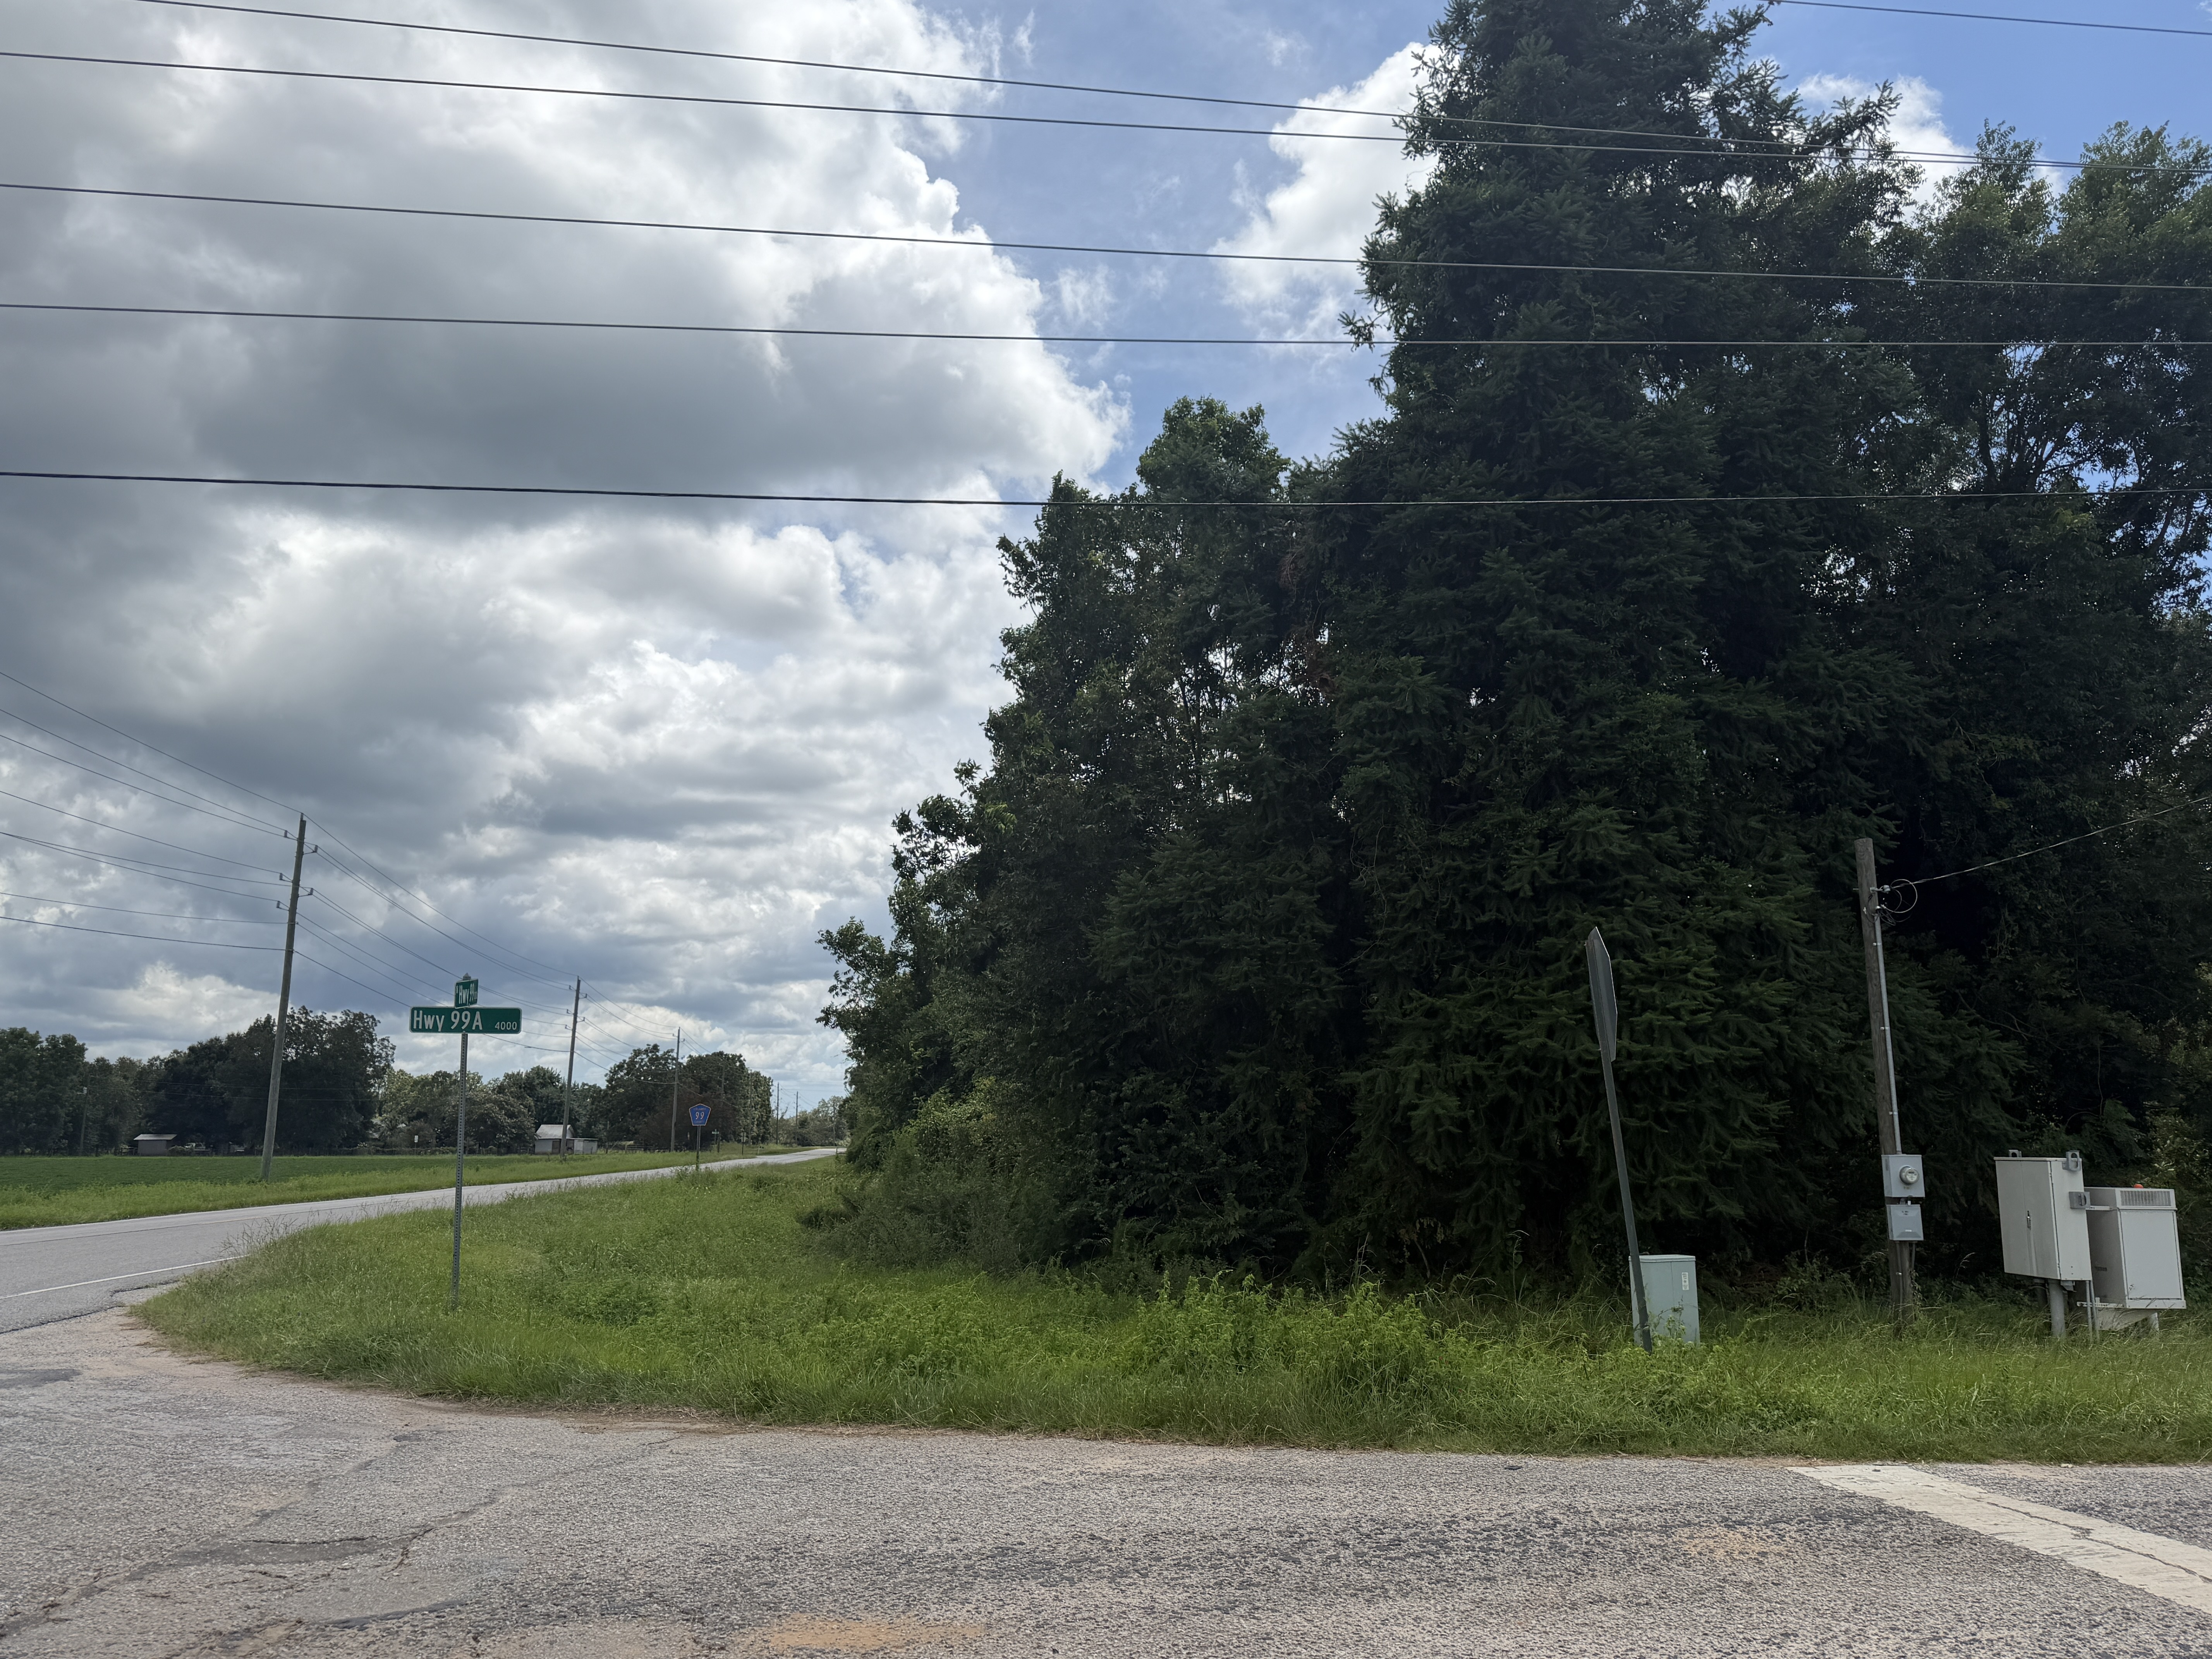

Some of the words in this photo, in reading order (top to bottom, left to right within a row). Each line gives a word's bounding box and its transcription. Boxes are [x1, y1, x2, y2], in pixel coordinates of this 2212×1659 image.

[459, 985, 469, 1005] Hwy
[470, 983, 474, 1002] 99
[413, 1010, 445, 1032] Hwy
[451, 1010, 483, 1030] 99A
[495, 1022, 517, 1030] 4000
